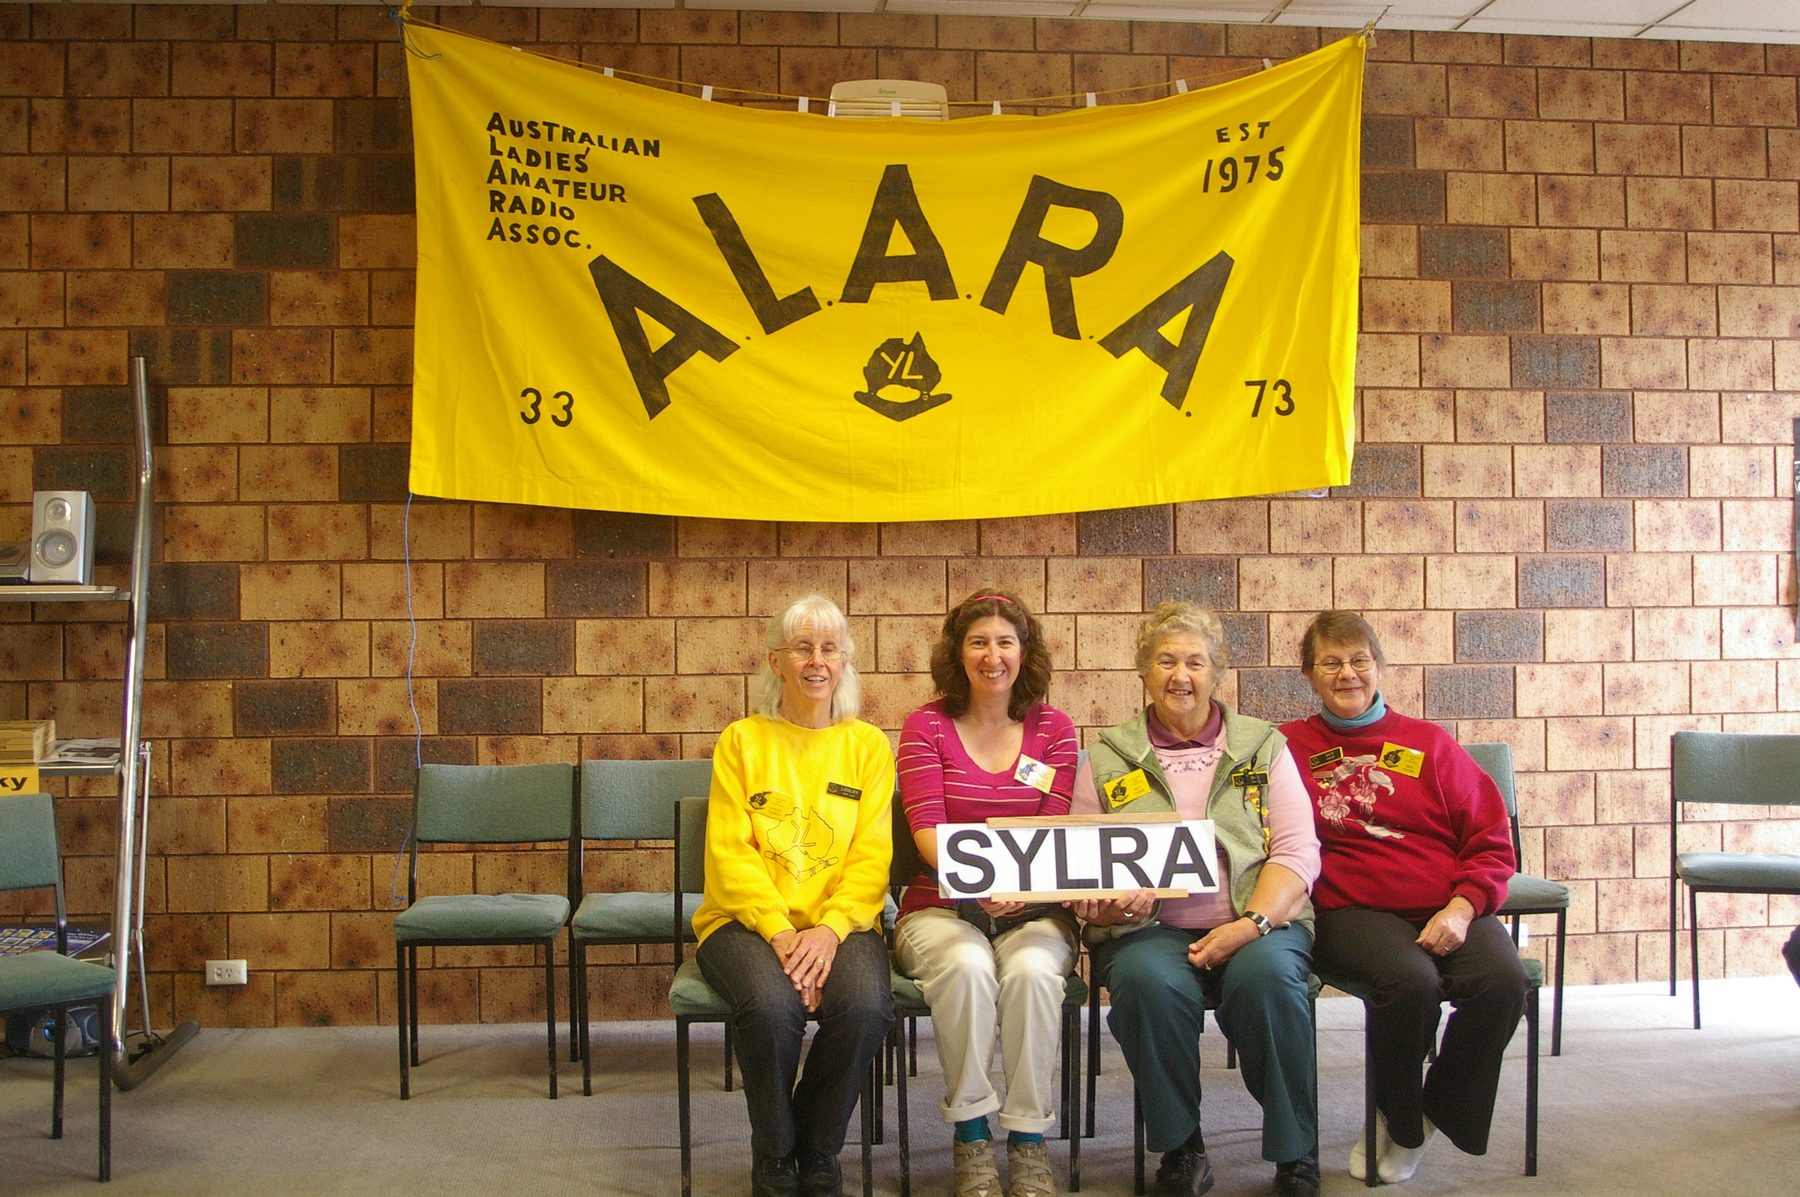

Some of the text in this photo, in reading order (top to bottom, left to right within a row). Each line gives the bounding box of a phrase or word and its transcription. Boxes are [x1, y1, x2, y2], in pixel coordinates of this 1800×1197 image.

[486, 112, 661, 157] AUSTRALIAN
[1216, 121, 1271, 143] EST
[486, 159, 627, 203] AMATEUR
[1203, 146, 1285, 193] 1975
[489, 190, 575, 220] RADIO
[486, 217, 592, 250] ASSOC.
[880, 351, 924, 379] YL
[520, 387, 574, 428] 33
[1245, 379, 1295, 418] 73
[945, 826, 1216, 894] SYLRA
